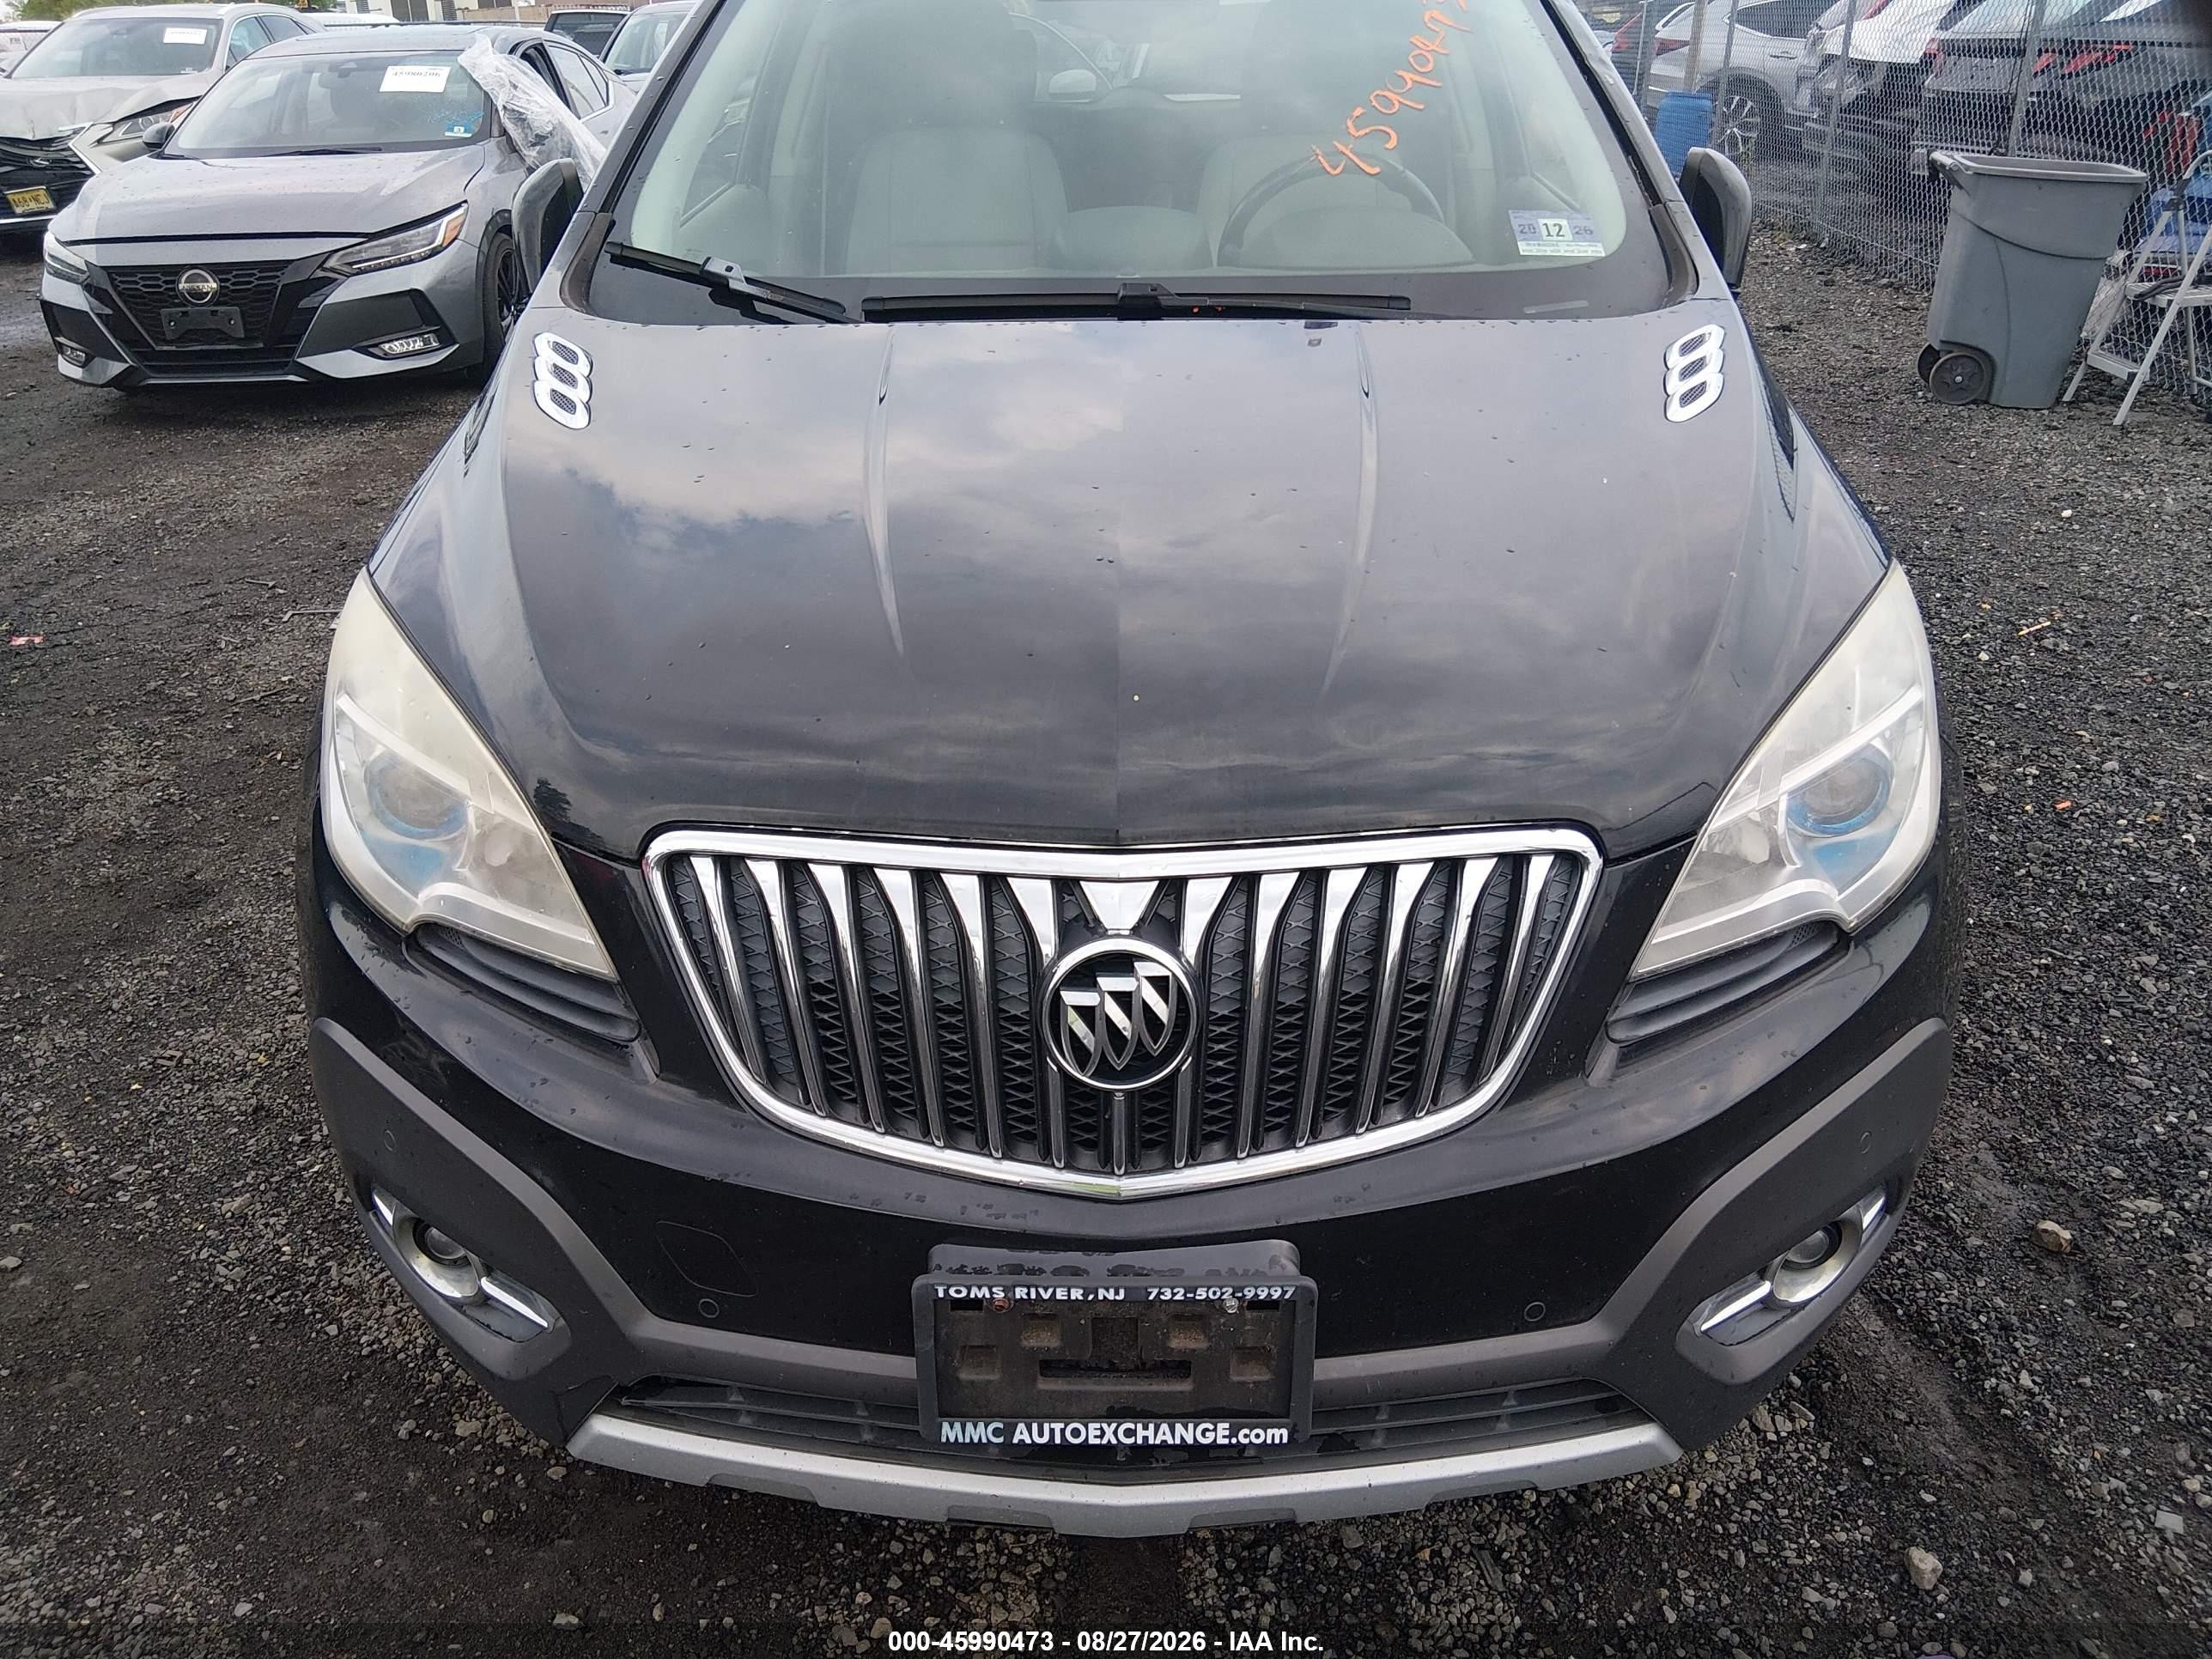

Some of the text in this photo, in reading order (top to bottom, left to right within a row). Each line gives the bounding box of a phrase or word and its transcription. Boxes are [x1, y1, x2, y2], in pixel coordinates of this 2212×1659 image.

[1542, 222, 1565, 237] 12
[934, 1285, 1005, 1299] TOMS
[1147, 1286, 1296, 1301] 732-502-9997
[940, 1422, 1288, 1445] MMC AUTOEXCHANGE.com
